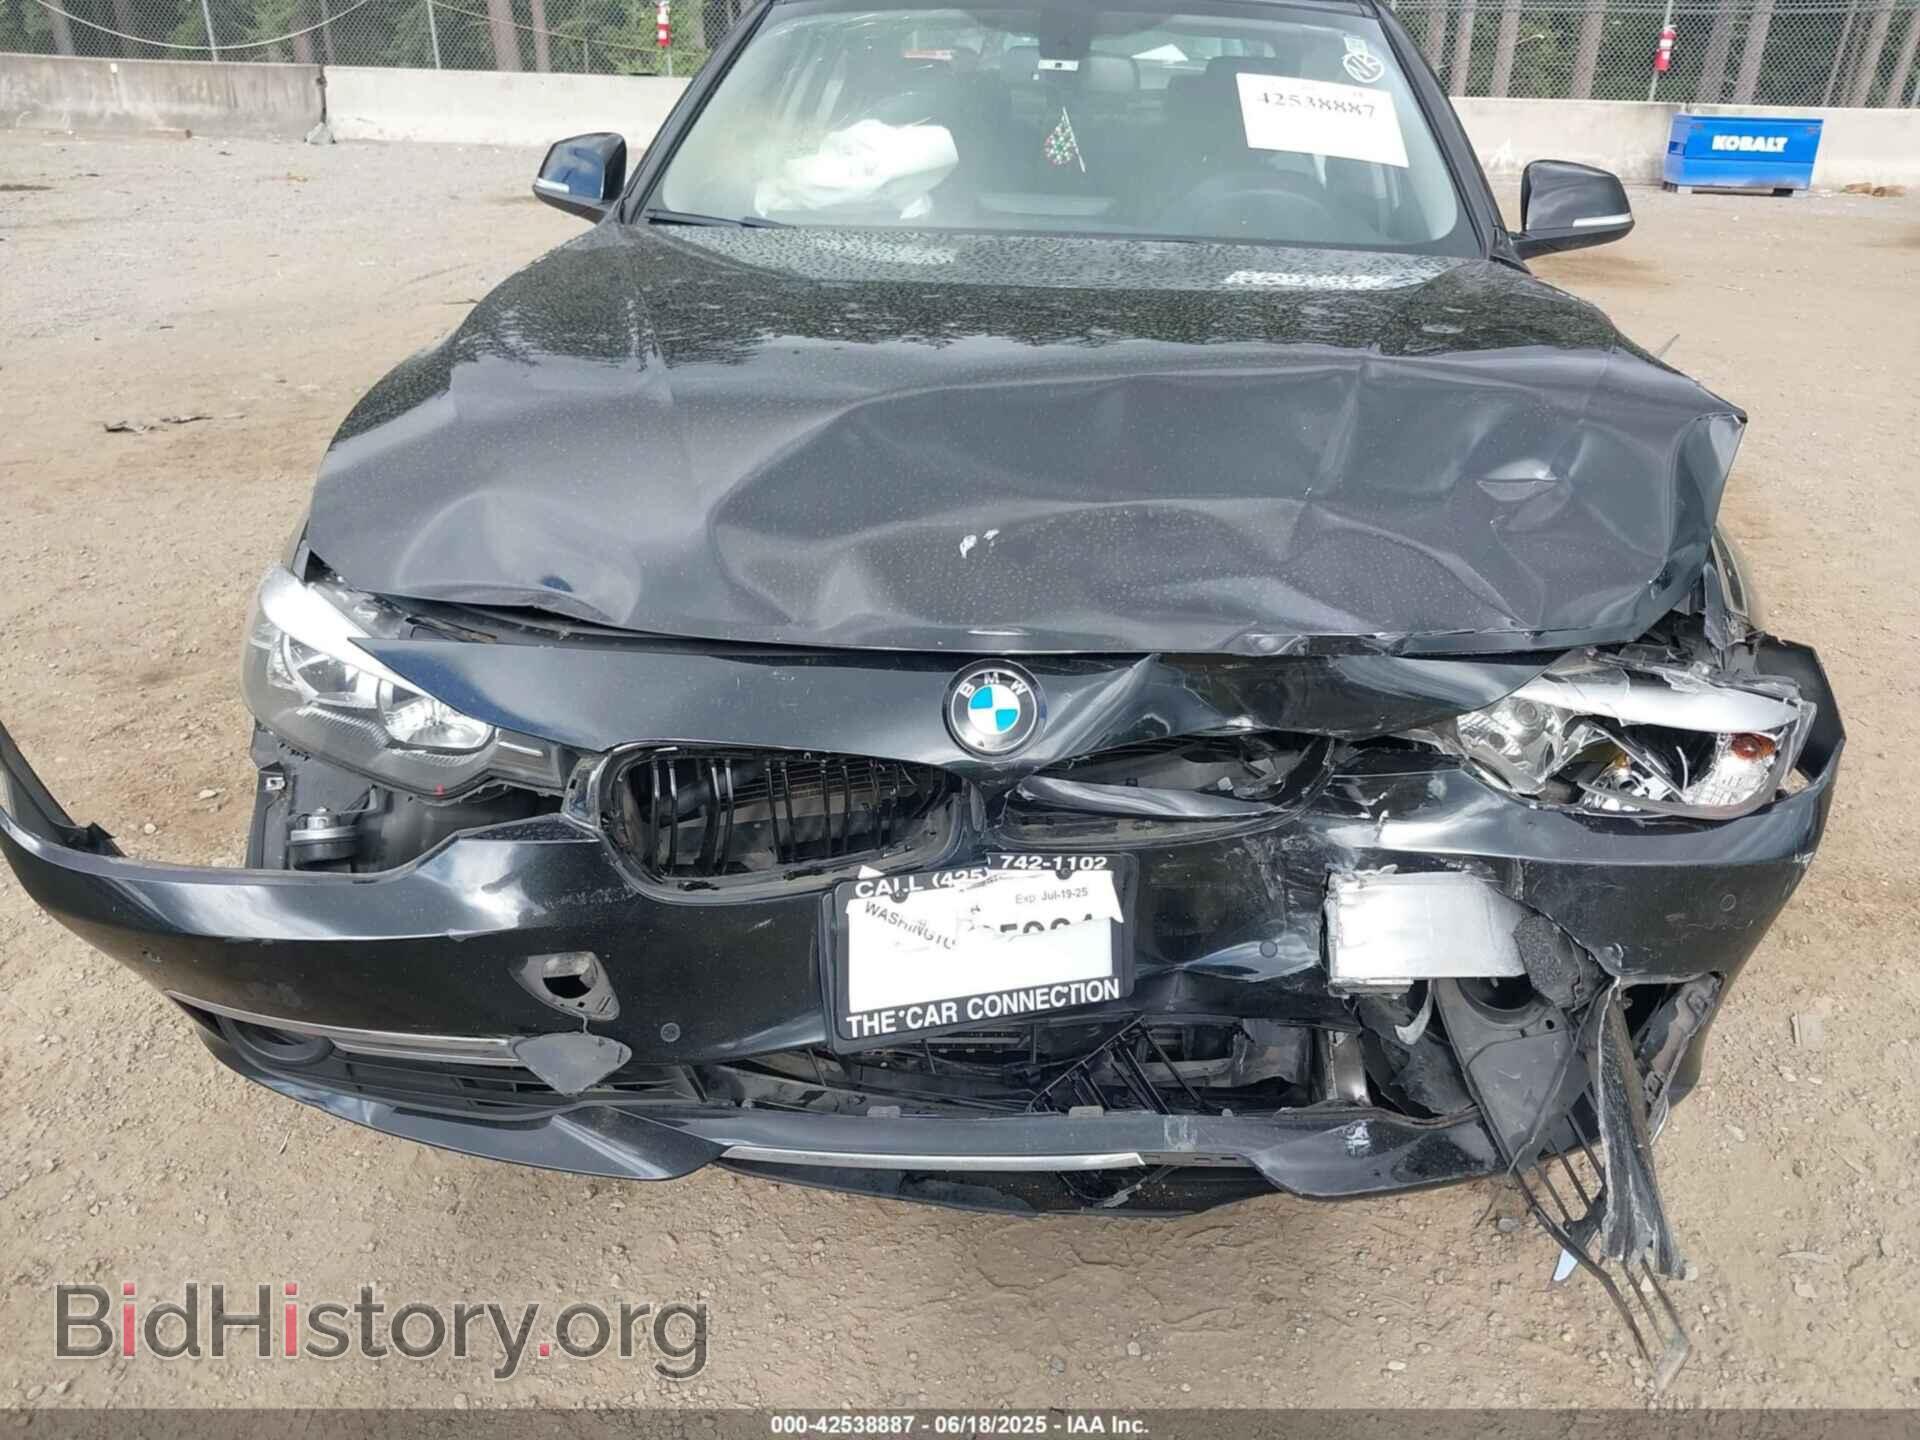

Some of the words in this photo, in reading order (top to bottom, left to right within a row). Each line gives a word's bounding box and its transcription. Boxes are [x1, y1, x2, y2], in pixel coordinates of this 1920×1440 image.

[1257, 91, 1375, 120] 42538887
[1711, 134, 1788, 152] KOBALT
[959, 671, 1028, 698] BMW
[855, 876, 925, 898] CALL
[1000, 854, 1107, 871] 742-1102
[1040, 887, 1089, 903] Jul-19-25
[846, 1010, 897, 1039] THE
[906, 1002, 957, 1028] CAR
[966, 978, 1121, 1020] CONNECTION
